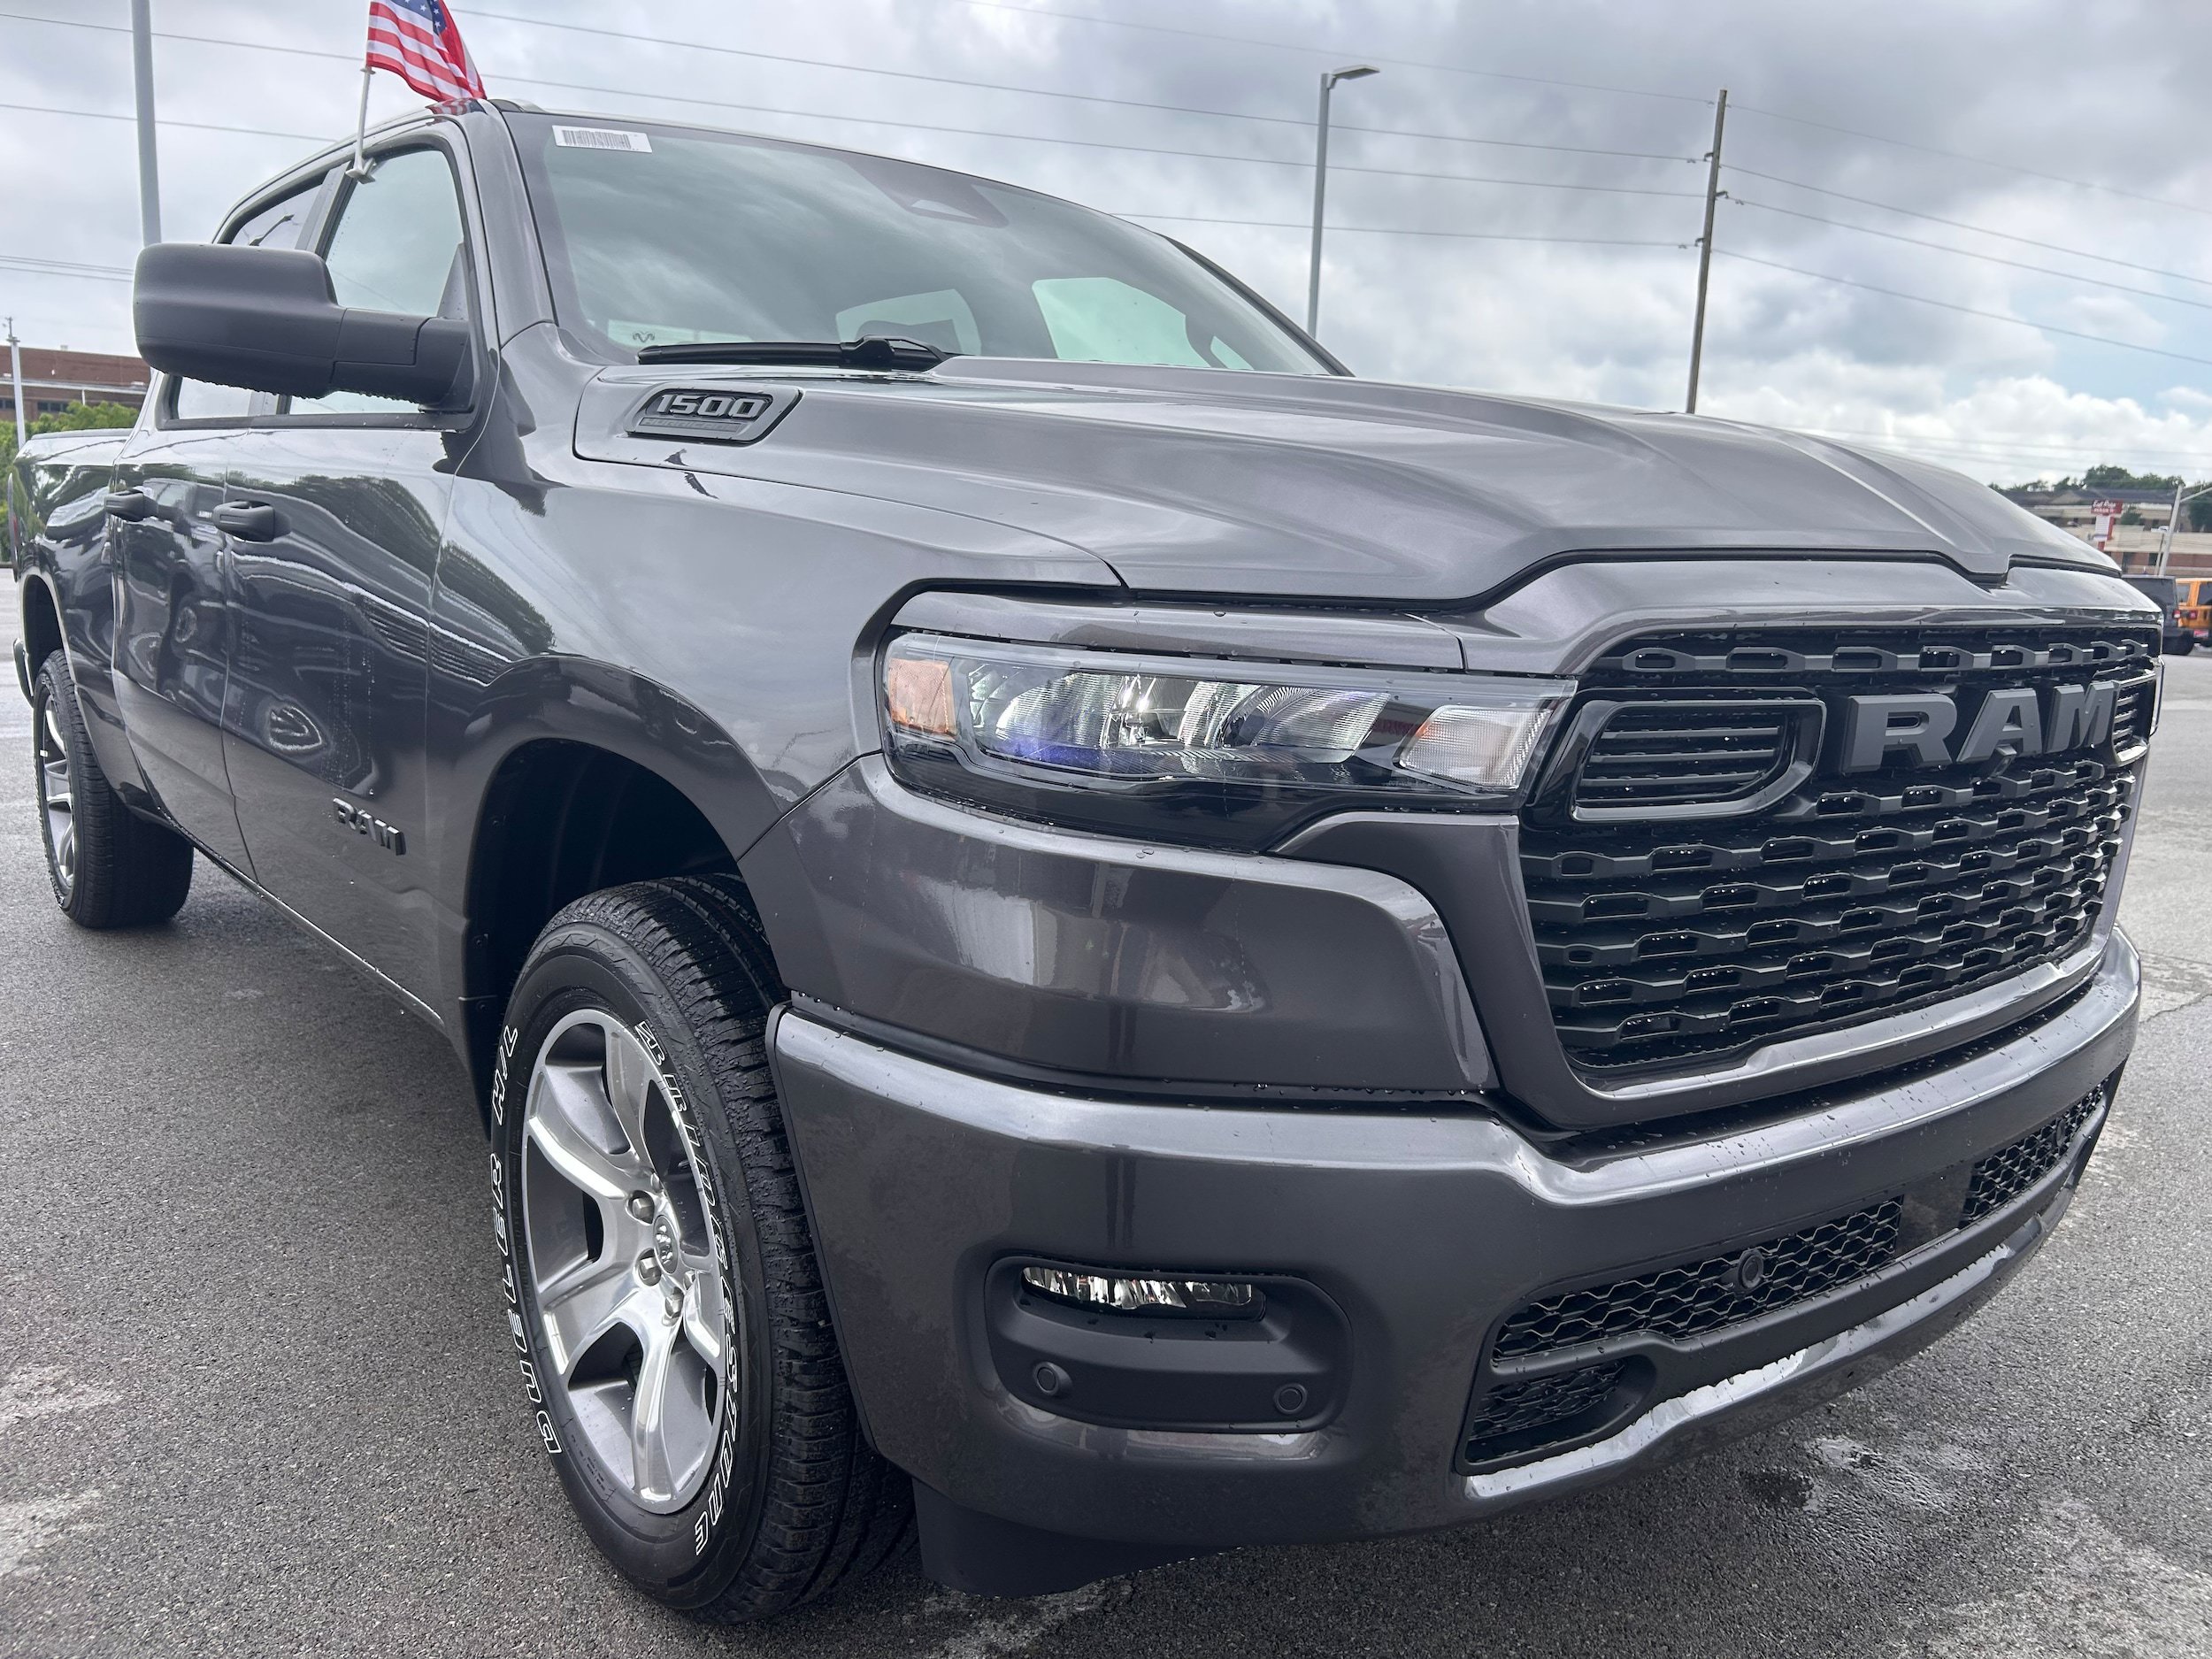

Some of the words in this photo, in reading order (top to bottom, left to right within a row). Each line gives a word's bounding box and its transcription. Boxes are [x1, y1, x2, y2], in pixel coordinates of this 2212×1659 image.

[656, 394, 765, 419] 1500
[1842, 682, 2116, 773] RAM
[333, 797, 406, 856] RAM
[490, 1153, 563, 1454] DUELER
[634, 1020, 738, 1555] BRIDGESTONE
